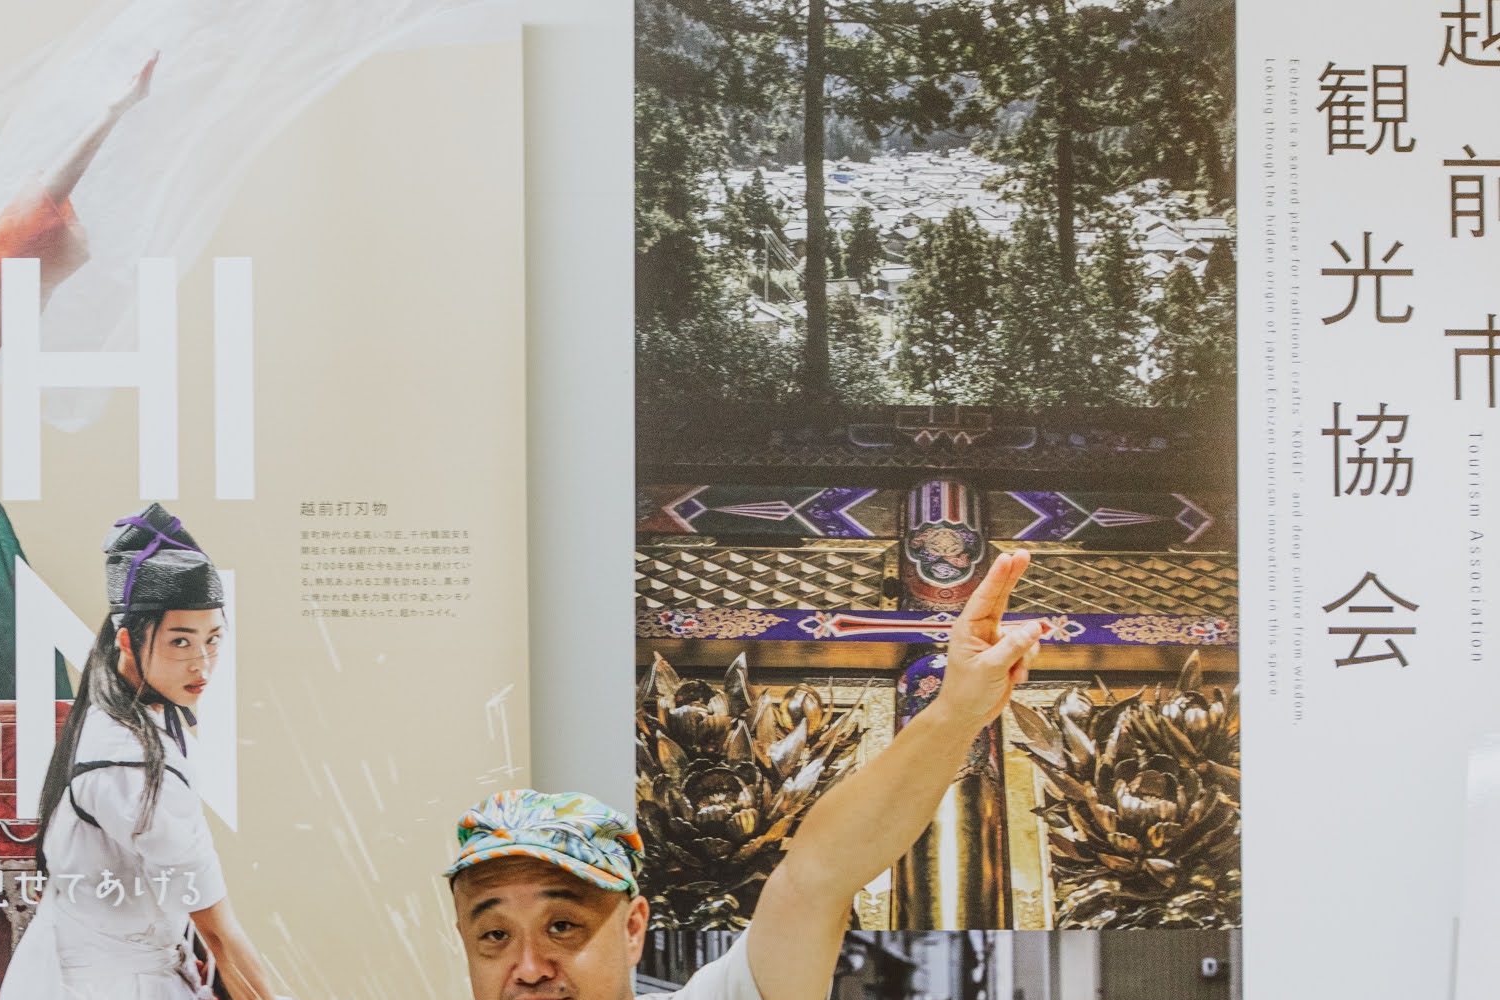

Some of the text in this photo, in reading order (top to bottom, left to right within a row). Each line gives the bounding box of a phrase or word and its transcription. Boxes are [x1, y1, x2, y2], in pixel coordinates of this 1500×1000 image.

[1262, 57, 1277, 114] Looking
[1288, 57, 1301, 115] Echizen
[1263, 121, 1277, 178] through
[1265, 185, 1277, 207] the
[1265, 214, 1277, 263] hidden
[1287, 212, 1301, 251] place
[1263, 270, 1277, 313] origin
[1316, 62, 1420, 668] 観光協会
[1267, 451, 1278, 507] tourism
[1291, 490, 1304, 517] and
[300, 501, 388, 516] 越前打刃物
[1267, 514, 1278, 592] innovation
[1468, 432, 1485, 663] Tourism Association
[1268, 618, 1280, 647] this
